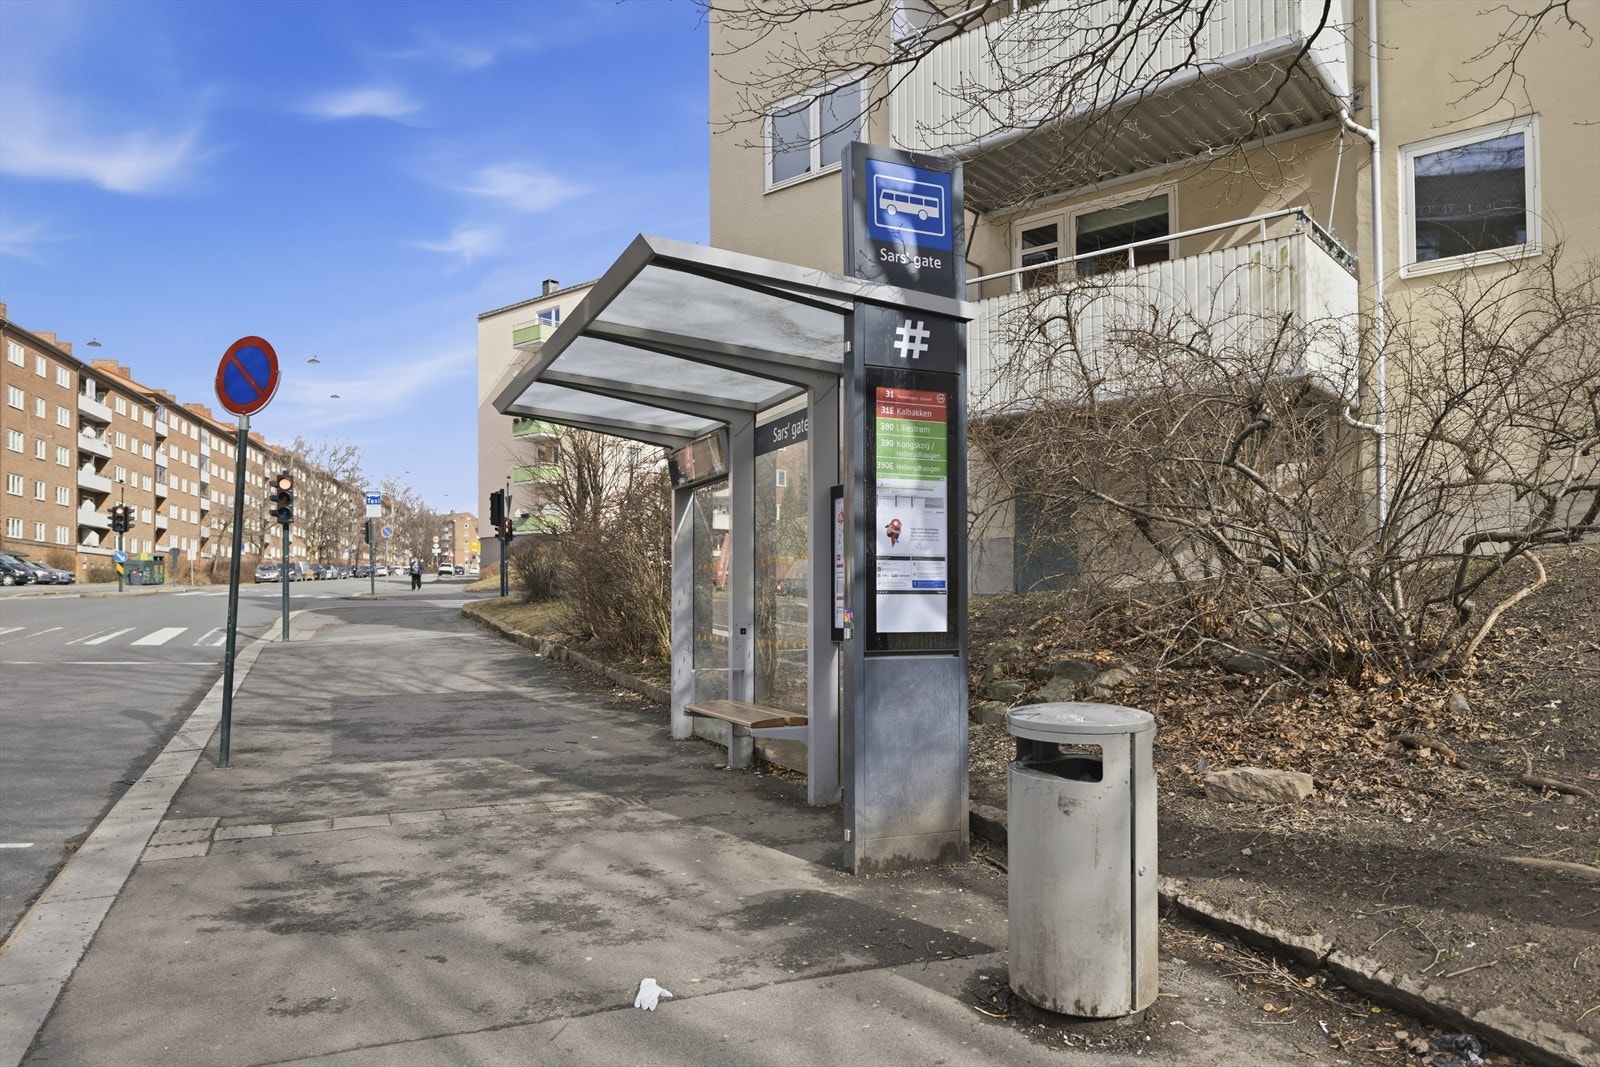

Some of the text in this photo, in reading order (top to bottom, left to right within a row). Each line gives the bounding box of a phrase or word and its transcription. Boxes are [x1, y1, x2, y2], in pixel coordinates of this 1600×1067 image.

[880, 247, 942, 269] Sars' gate
[885, 389, 895, 398] 31
[881, 405, 932, 417] 31E Kalbakken
[773, 418, 809, 443] Sars' gate
[881, 422, 894, 431] 380
[881, 439, 894, 447] 390
